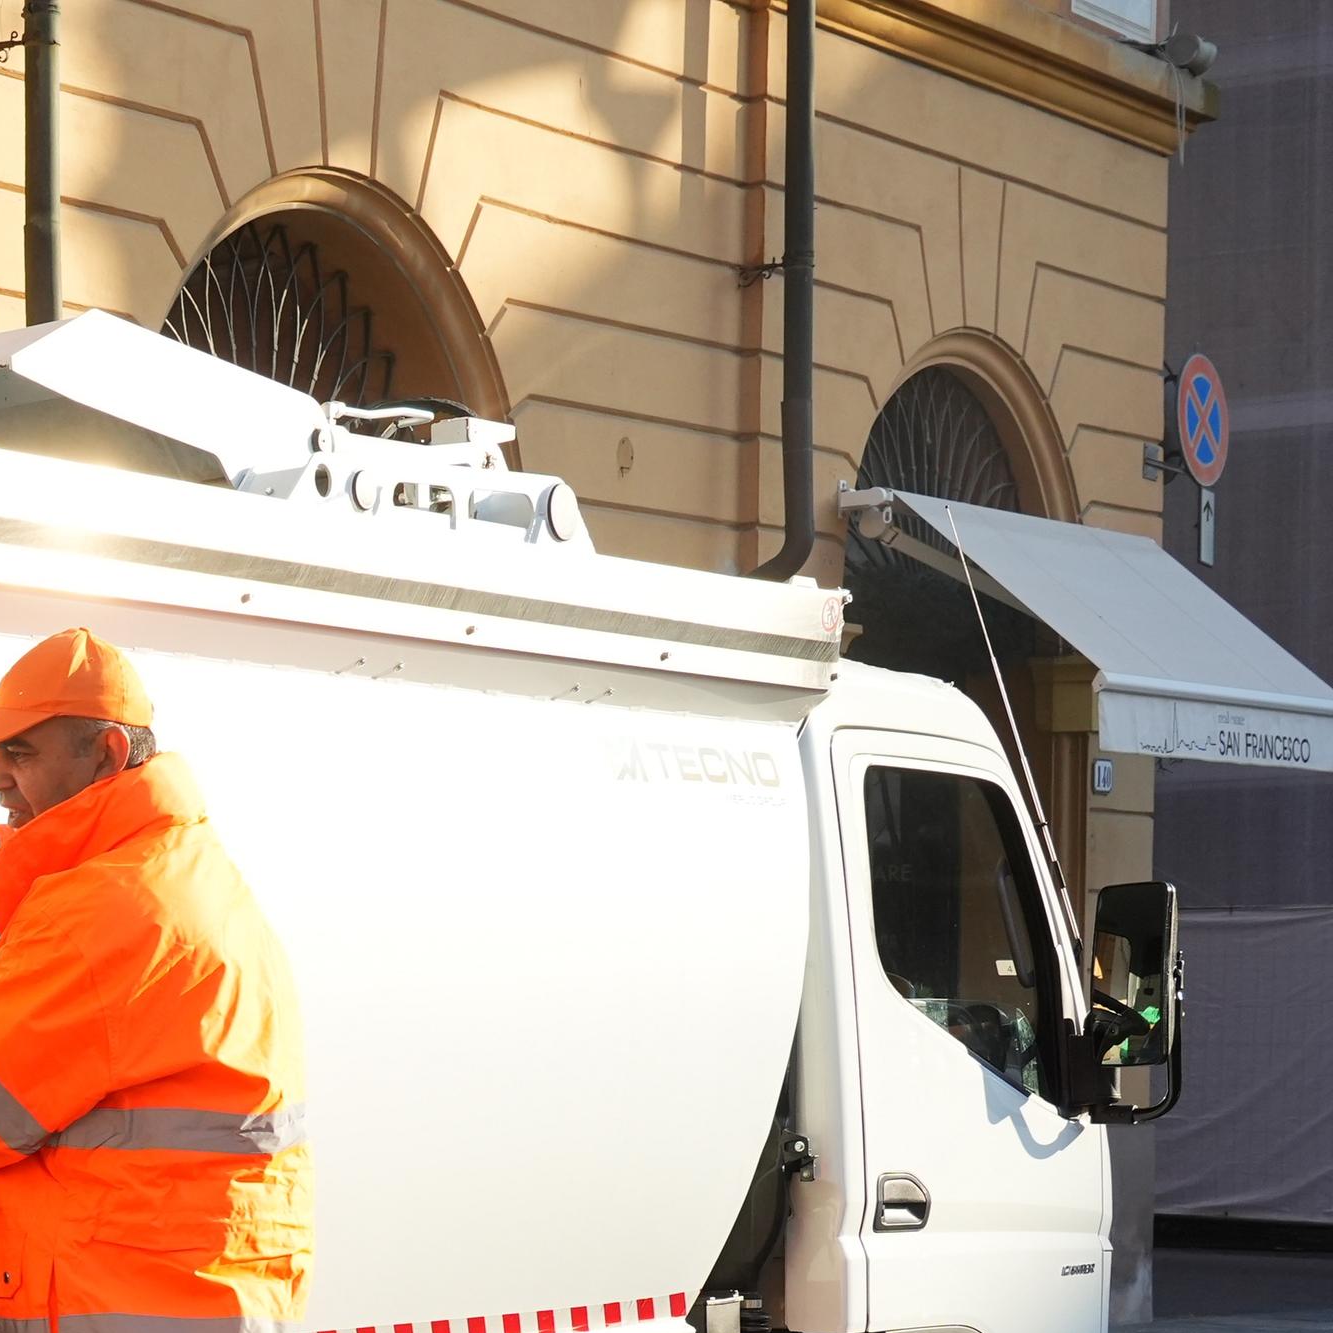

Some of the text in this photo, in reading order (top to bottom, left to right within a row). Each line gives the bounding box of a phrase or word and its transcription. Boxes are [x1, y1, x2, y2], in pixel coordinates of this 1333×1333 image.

[645, 742, 780, 788] TECNO
[1219, 730, 1311, 763] SAN FRANCESCO
